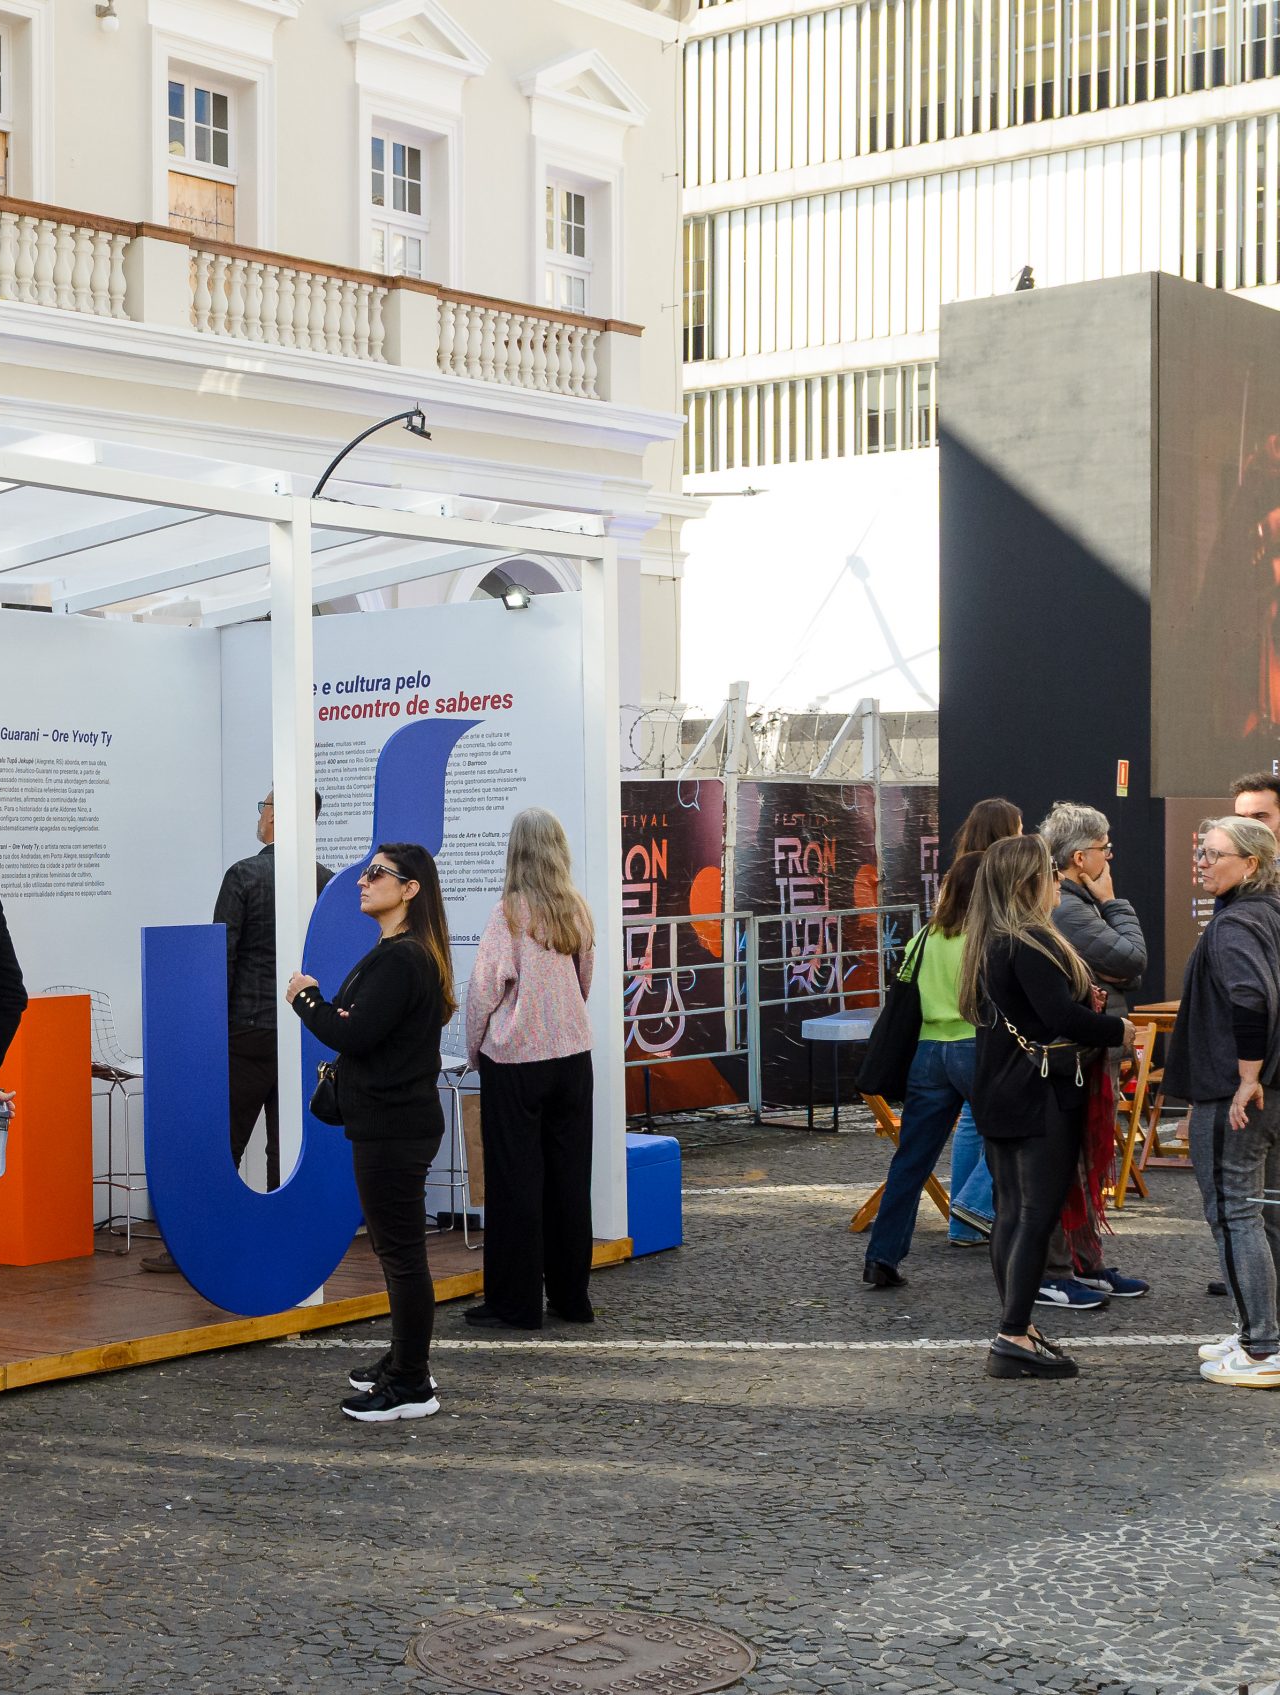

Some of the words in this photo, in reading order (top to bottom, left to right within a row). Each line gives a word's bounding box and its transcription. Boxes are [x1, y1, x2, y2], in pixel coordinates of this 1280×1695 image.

[322, 682, 331, 694] e
[336, 676, 391, 694] cultura
[395, 671, 431, 694] pelo
[319, 700, 400, 721] encontro
[406, 695, 429, 714] de
[435, 691, 513, 713] saberes
[1, 727, 39, 741] Guarani
[52, 729, 69, 742] Ore
[73, 730, 98, 746] Yvoty
[101, 731, 112, 747] Ty
[774, 837, 836, 874] FRON
